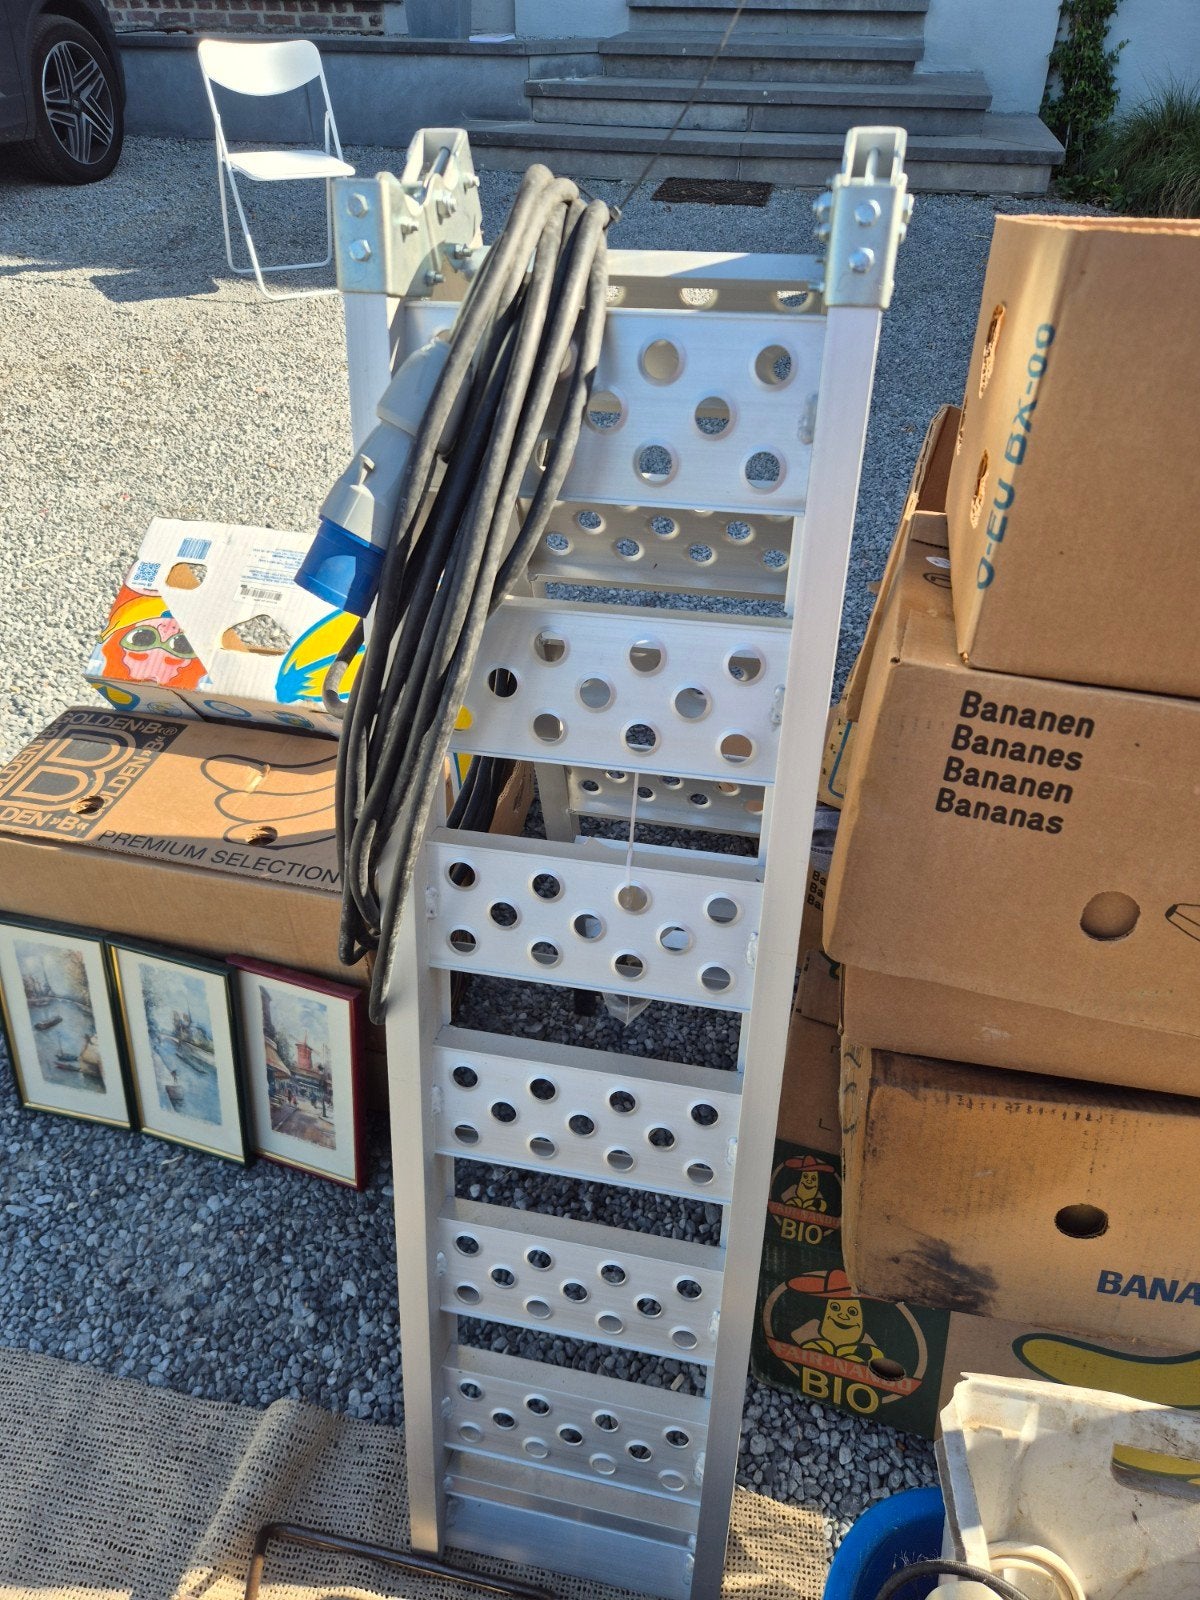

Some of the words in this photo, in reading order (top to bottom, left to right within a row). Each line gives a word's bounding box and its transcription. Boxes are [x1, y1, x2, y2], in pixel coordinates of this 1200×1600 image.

[959, 689, 1095, 739] Bananen
[951, 723, 1083, 771] Bananes
[943, 756, 1074, 804] Bananen
[935, 787, 1064, 835] Bananas
[97, 829, 208, 861] PREMIUM
[210, 850, 340, 885] SELECTION
[780, 1217, 823, 1245] BIO
[1096, 1269, 1200, 1307] BANA
[801, 1365, 879, 1414] BIO
